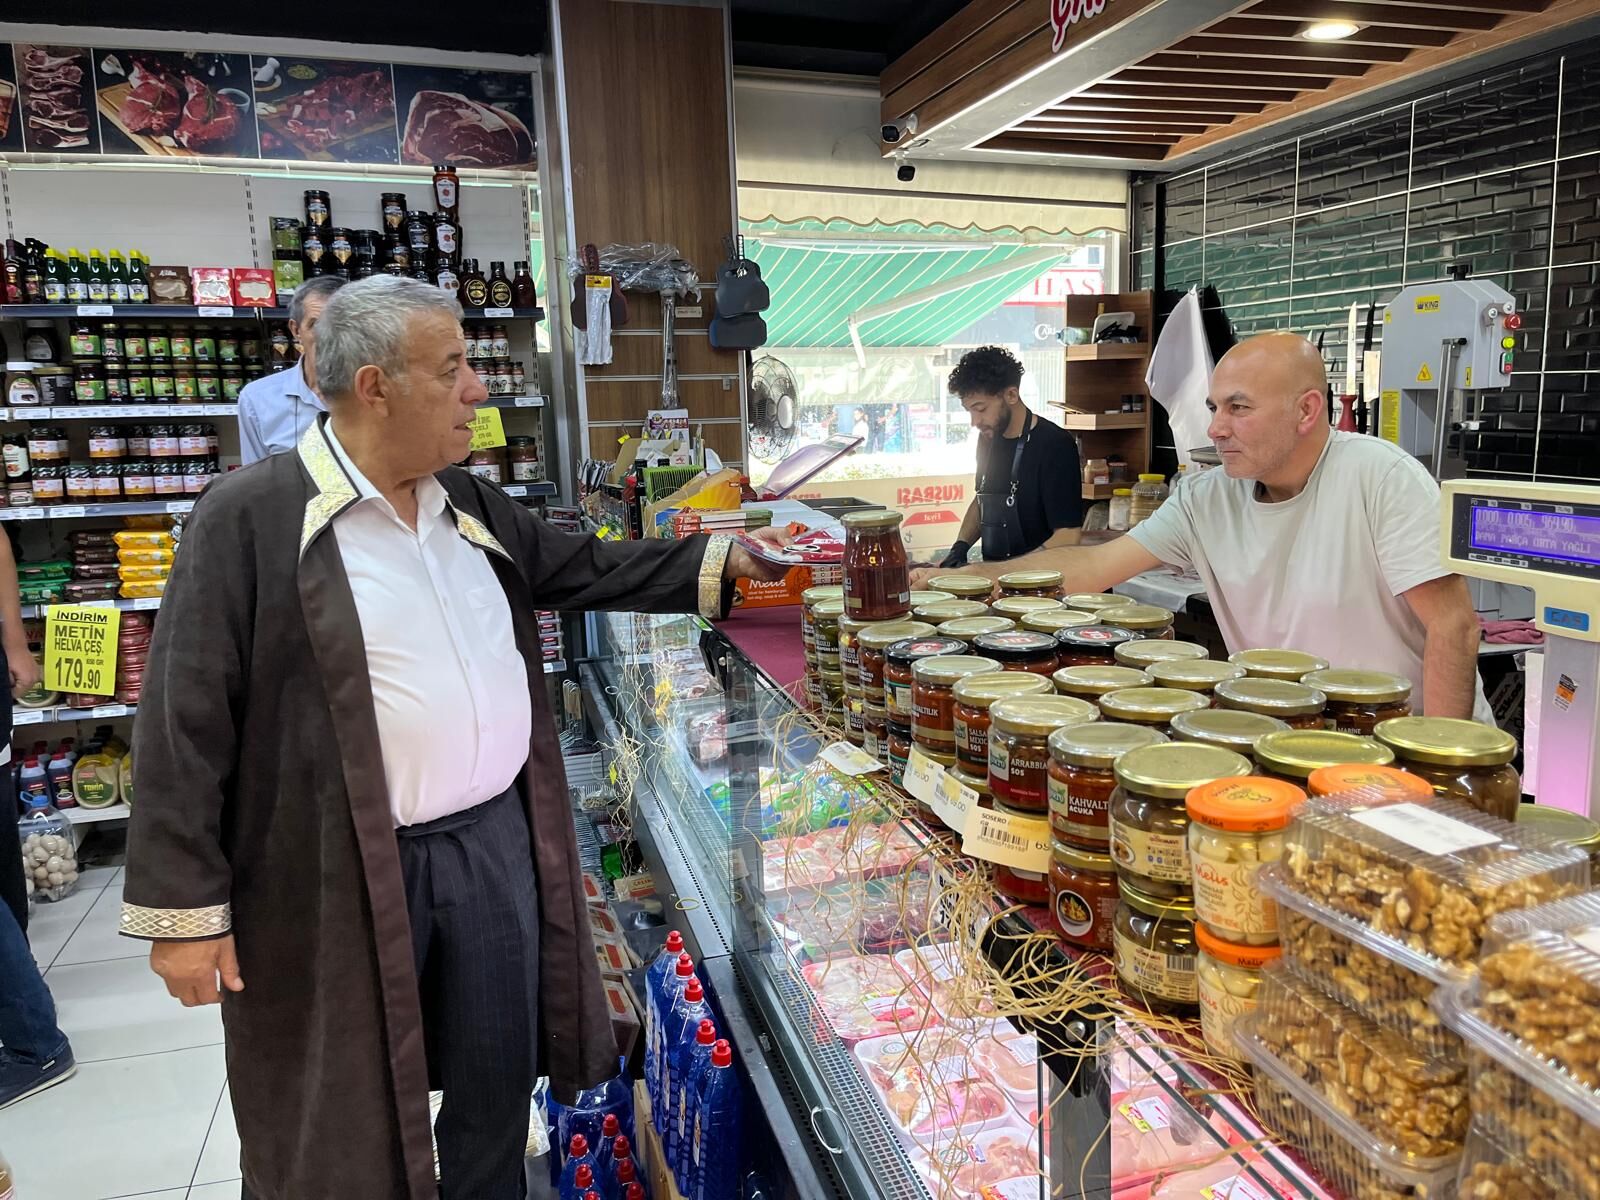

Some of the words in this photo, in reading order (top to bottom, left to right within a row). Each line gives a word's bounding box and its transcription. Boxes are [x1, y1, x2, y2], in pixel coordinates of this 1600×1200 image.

[56, 610, 108, 623] İNDİRİM
[54, 624, 105, 641] METİN
[54, 637, 82, 652] HELVA
[84, 639, 105, 657] ÇEŞ.
[55, 656, 101, 690] 179.90
[969, 736, 988, 745] MEXIC
[970, 744, 982, 753] SOS
[1010, 758, 1048, 770] ARRABBIA
[1010, 769, 1025, 777] SOS
[1068, 795, 1109, 810] KAHVALT
[1069, 805, 1094, 816] ACUKA
